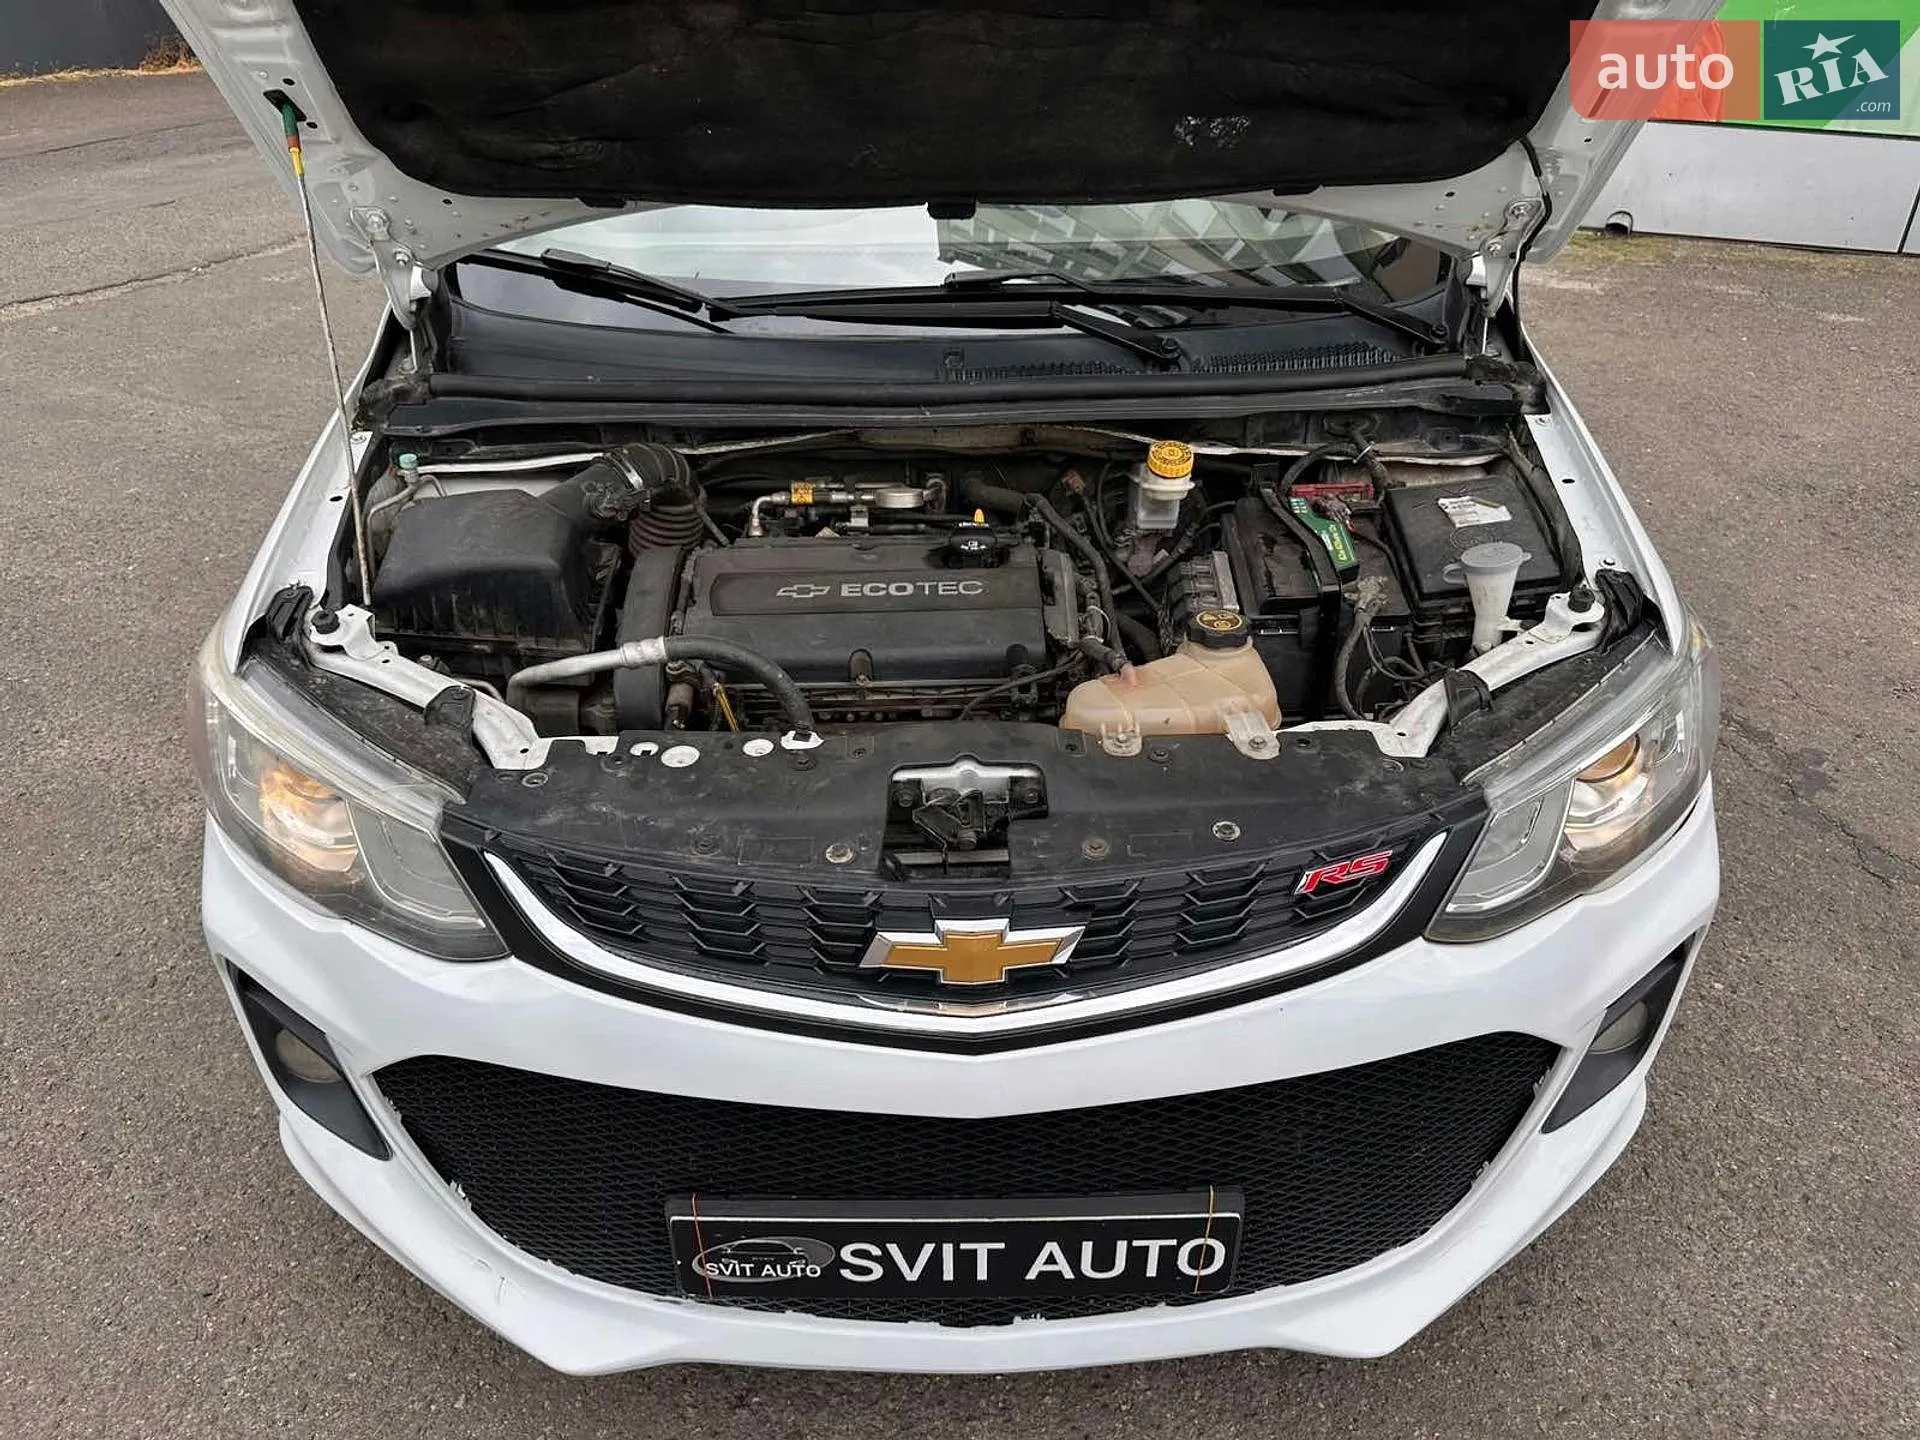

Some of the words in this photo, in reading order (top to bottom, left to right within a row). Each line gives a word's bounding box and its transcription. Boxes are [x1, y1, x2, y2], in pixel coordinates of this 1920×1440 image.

[840, 580, 984, 597] ECOTEC
[1294, 850, 1393, 895] RS
[706, 1262, 754, 1276] SVIT
[761, 1263, 821, 1278] AUTO
[838, 1242, 1006, 1282] SVIT
[1025, 1238, 1226, 1281] AUTO
